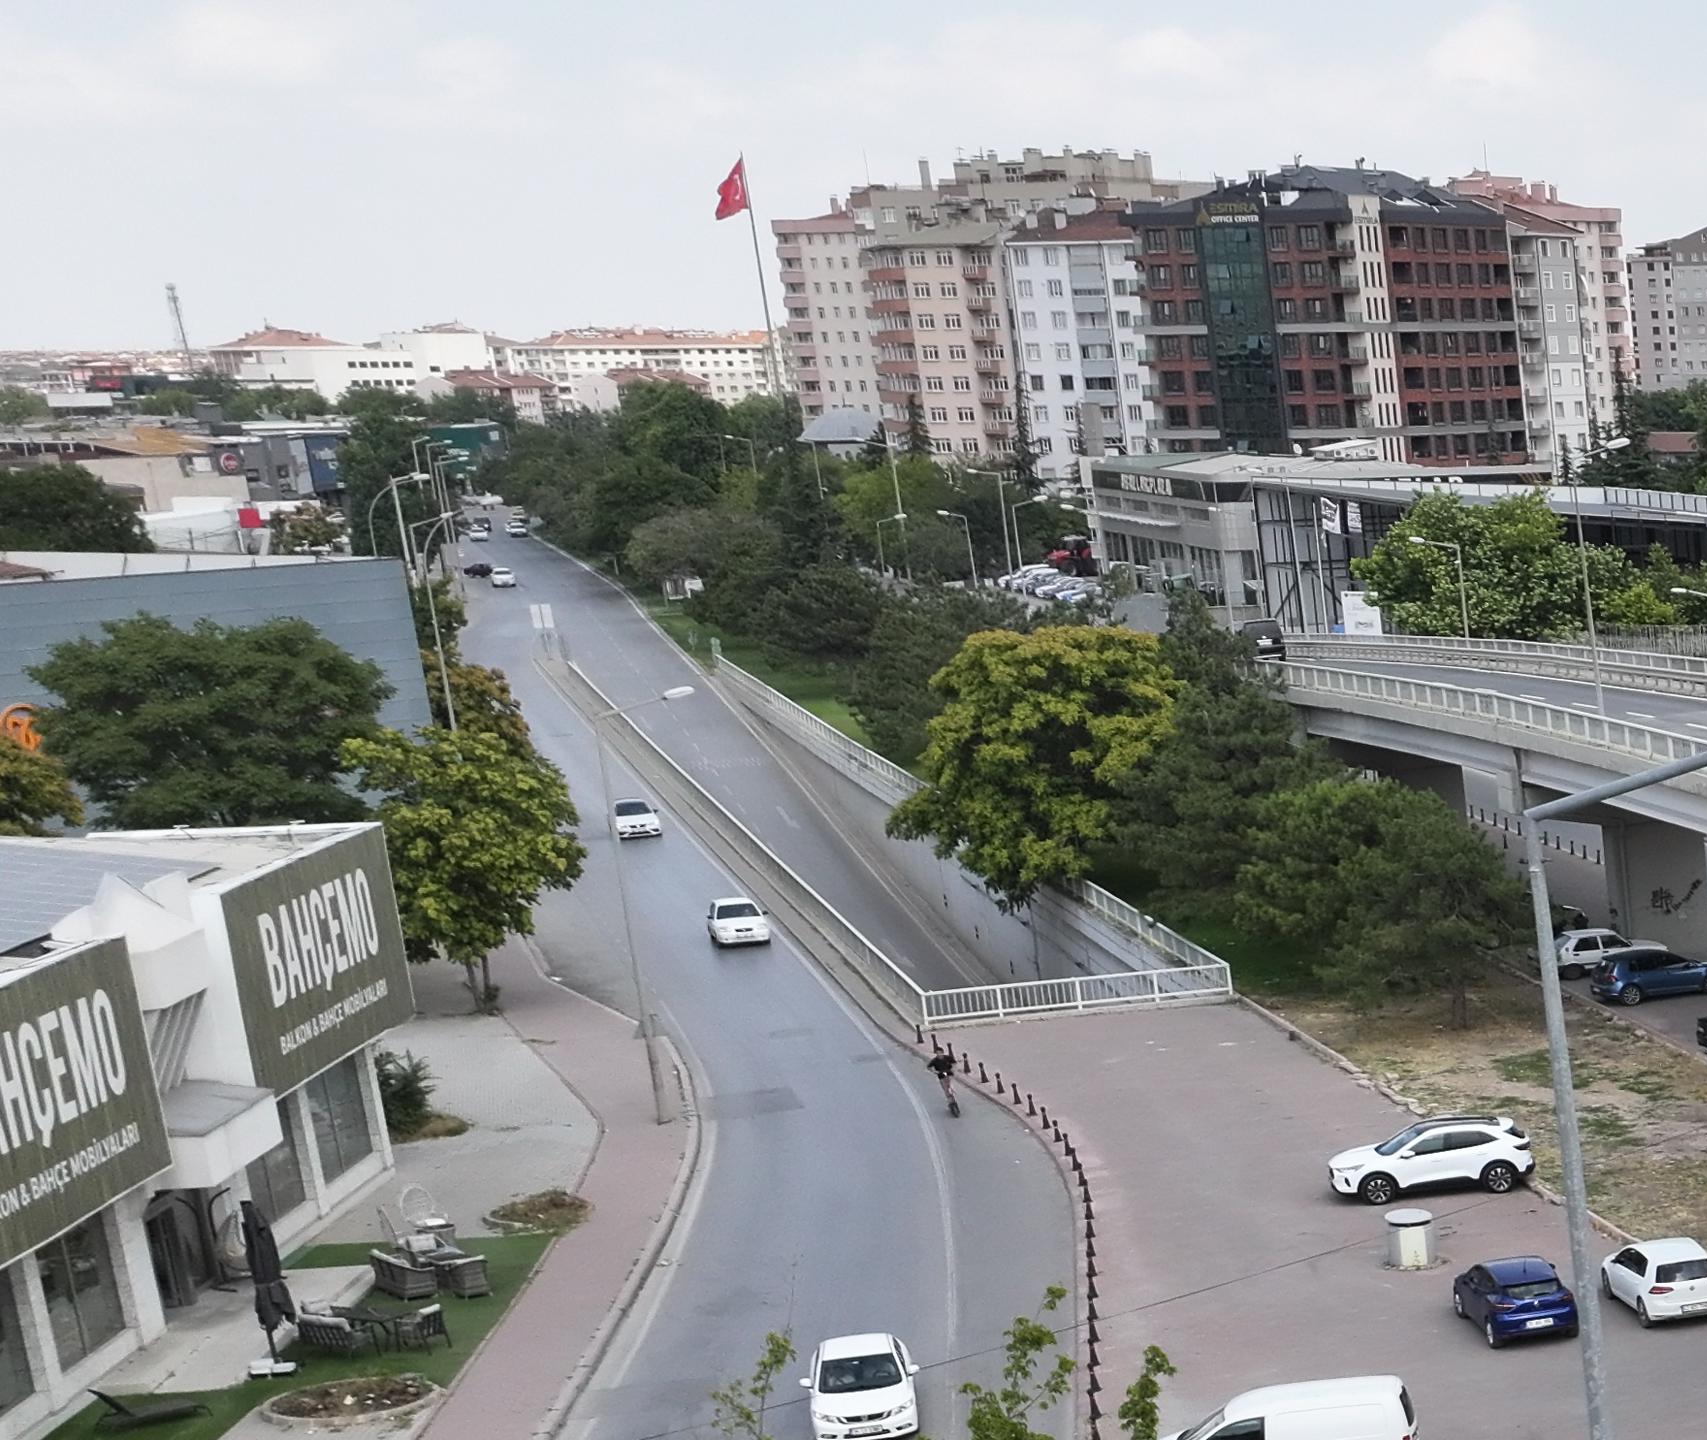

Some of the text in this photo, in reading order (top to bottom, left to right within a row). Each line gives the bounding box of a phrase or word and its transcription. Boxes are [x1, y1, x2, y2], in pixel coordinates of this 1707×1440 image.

[257, 868, 379, 1008] BAHÇEMO
[279, 1022, 313, 1056] BALKON
[29, 1159, 71, 1199] BAHÇE
[69, 1121, 142, 1179] MOBİLYALARI
